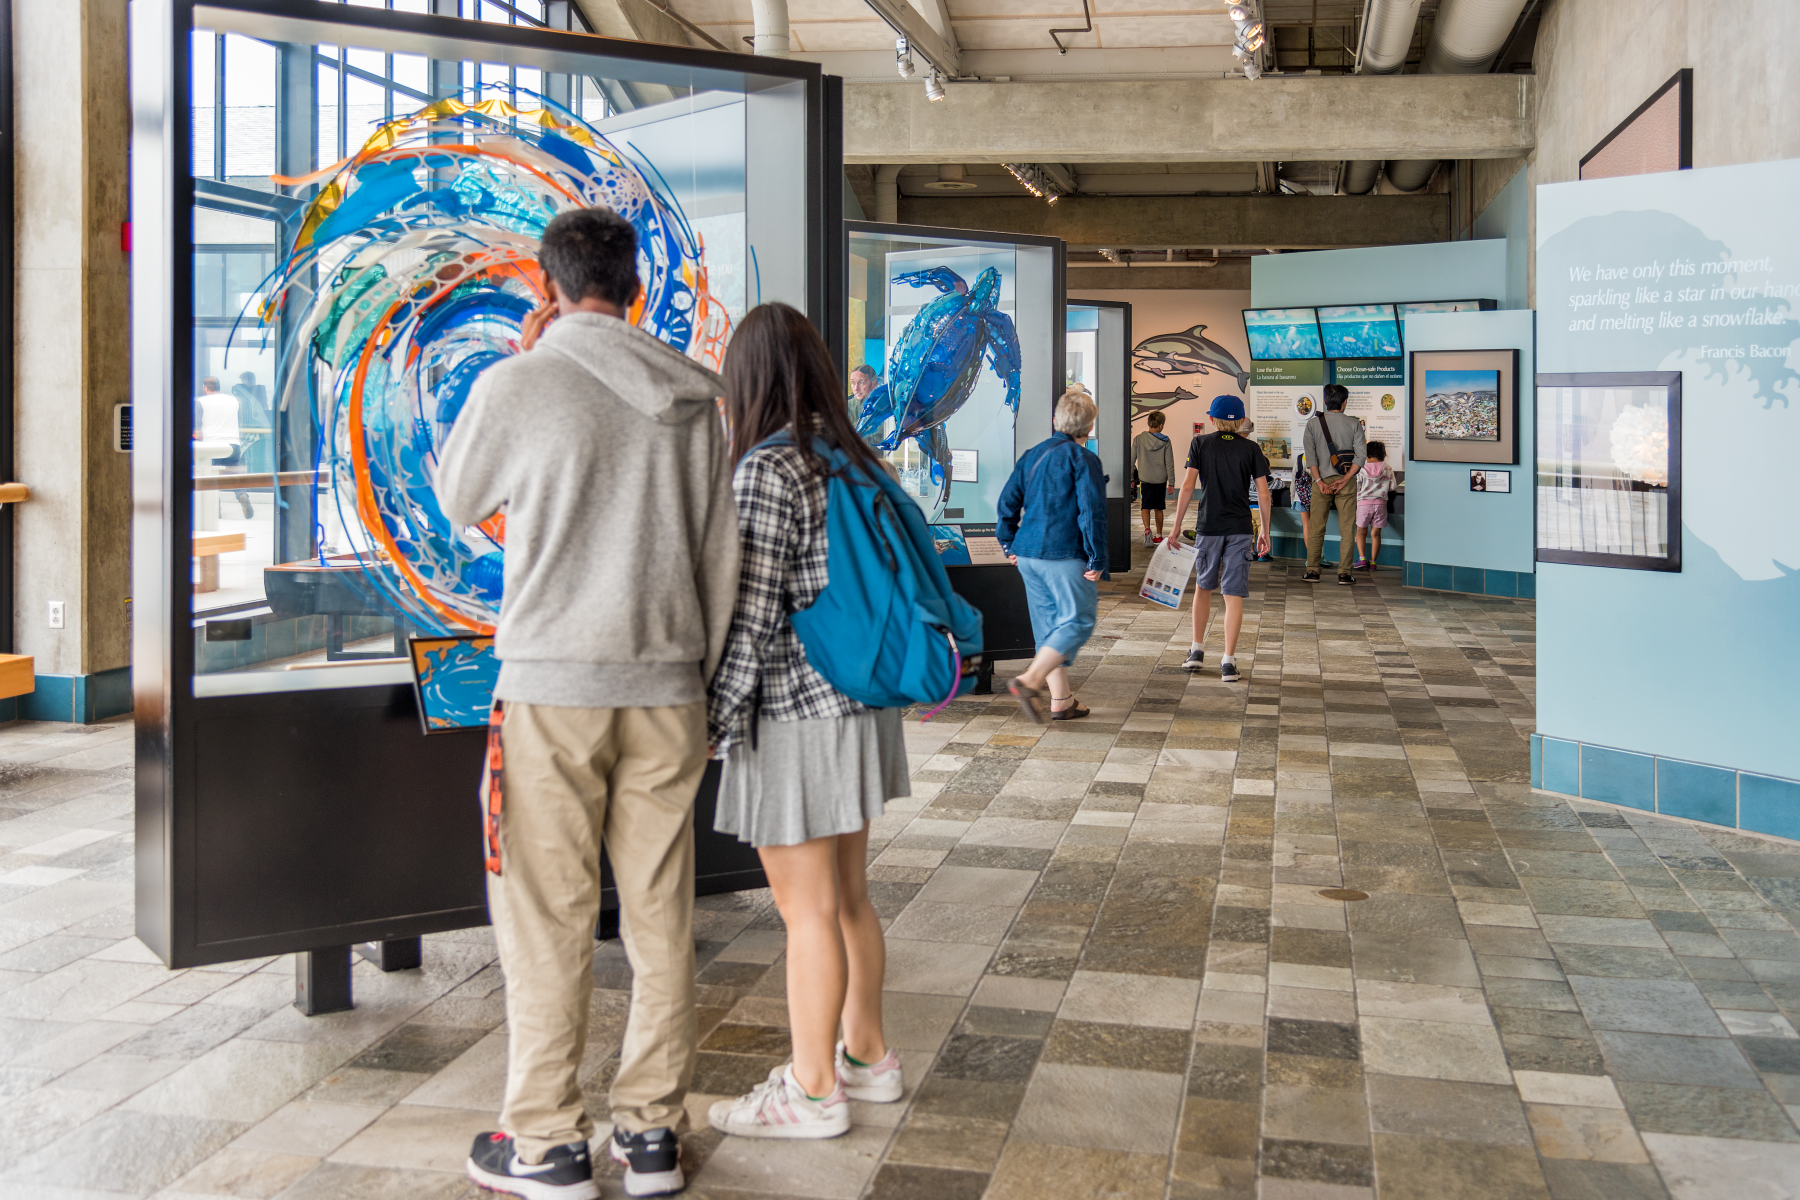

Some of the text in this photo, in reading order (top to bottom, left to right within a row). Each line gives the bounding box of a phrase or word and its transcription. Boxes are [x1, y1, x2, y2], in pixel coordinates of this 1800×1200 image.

[1570, 256, 1774, 283] We have only this moment,
[1568, 288, 1630, 311] sparkling
[1635, 286, 1659, 304] like
[1663, 291, 1672, 303] a
[1677, 286, 1706, 302] star
[1710, 283, 1725, 300] in
[1730, 286, 1759, 300] our
[1568, 307, 1786, 334] and melting like a snowflake.
[1700, 344, 1791, 358] Francis Bacon
